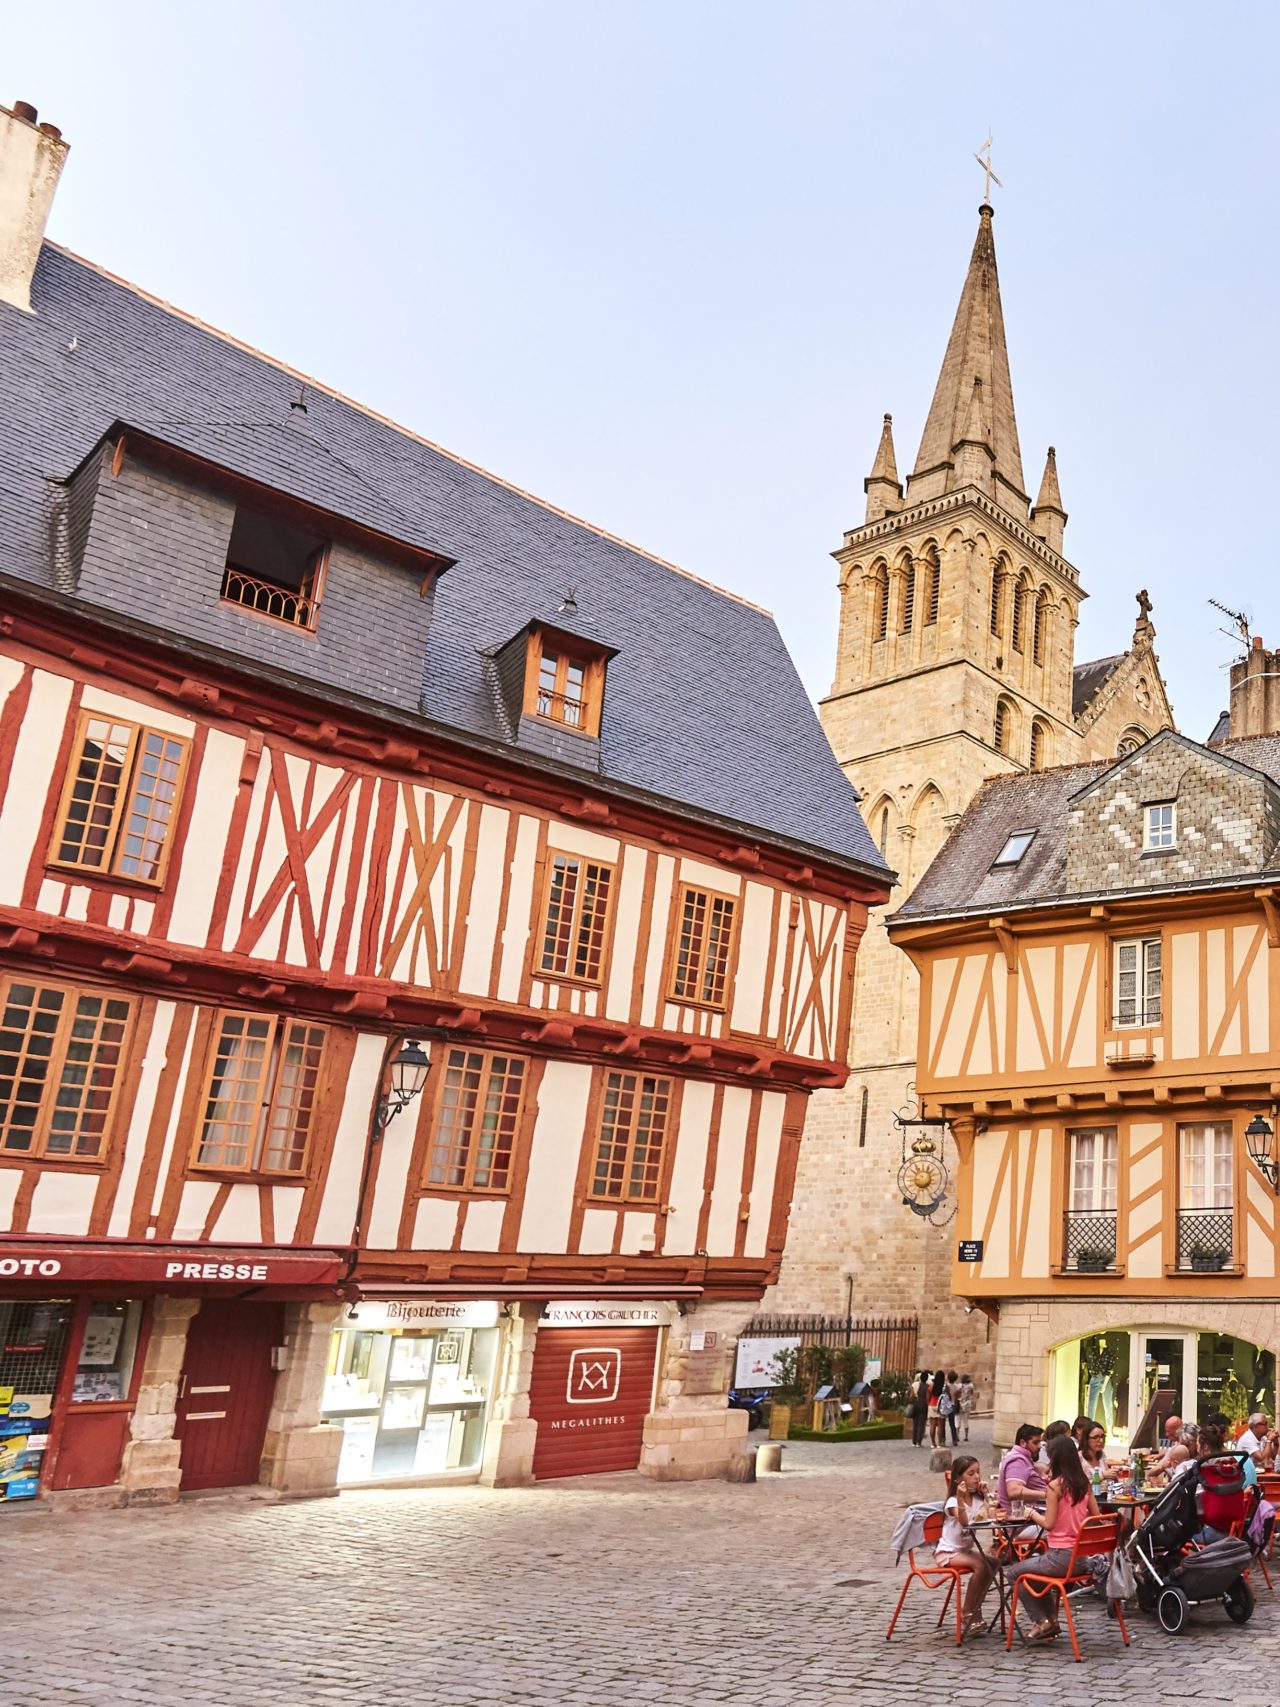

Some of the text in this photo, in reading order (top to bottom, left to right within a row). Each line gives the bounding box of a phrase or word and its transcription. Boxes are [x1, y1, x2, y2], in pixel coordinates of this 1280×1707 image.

[165, 1263, 268, 1281] PRESSE
[387, 1302, 466, 1322] Bijouterie
[551, 1416, 626, 1429] MEGALITHES
